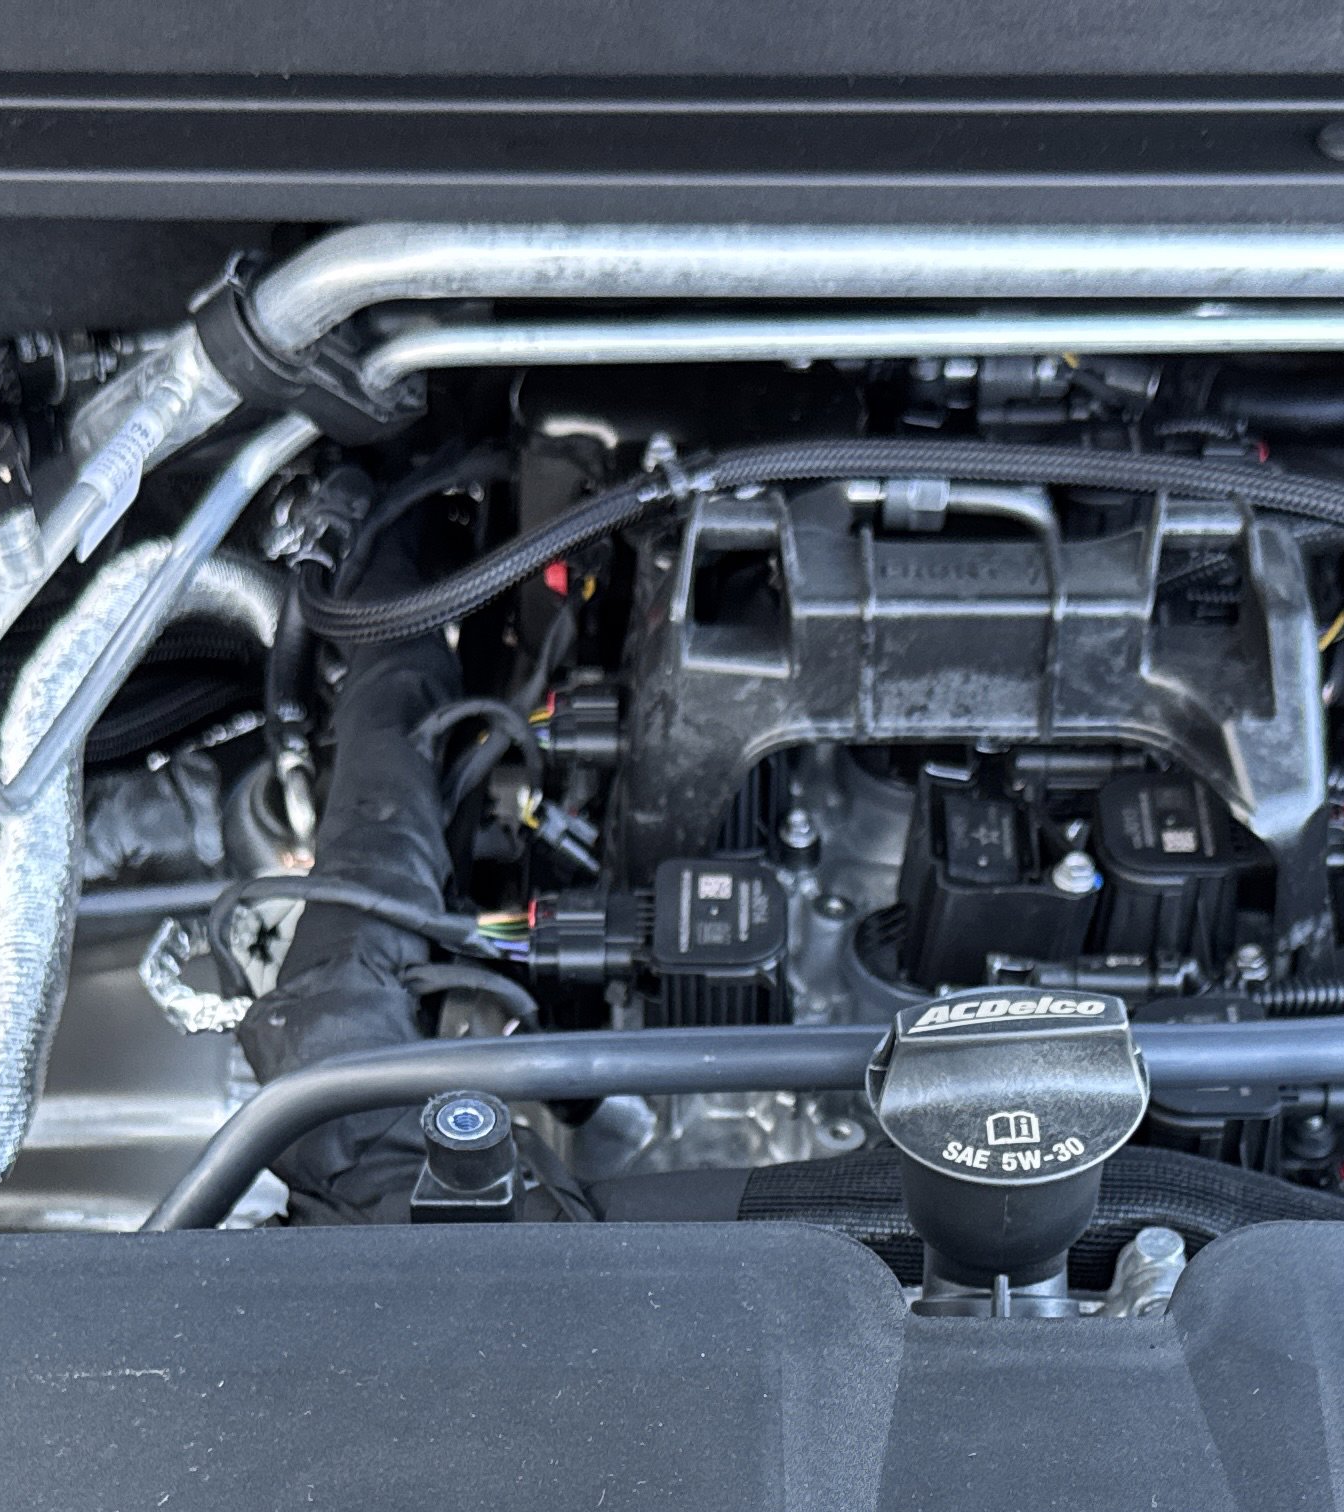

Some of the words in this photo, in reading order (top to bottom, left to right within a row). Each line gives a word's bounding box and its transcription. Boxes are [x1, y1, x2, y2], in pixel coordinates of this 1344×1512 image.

[912, 996, 1106, 1030] ACDelco
[942, 1141, 991, 1169] SAE
[1001, 1136, 1085, 1172] 5W-30
